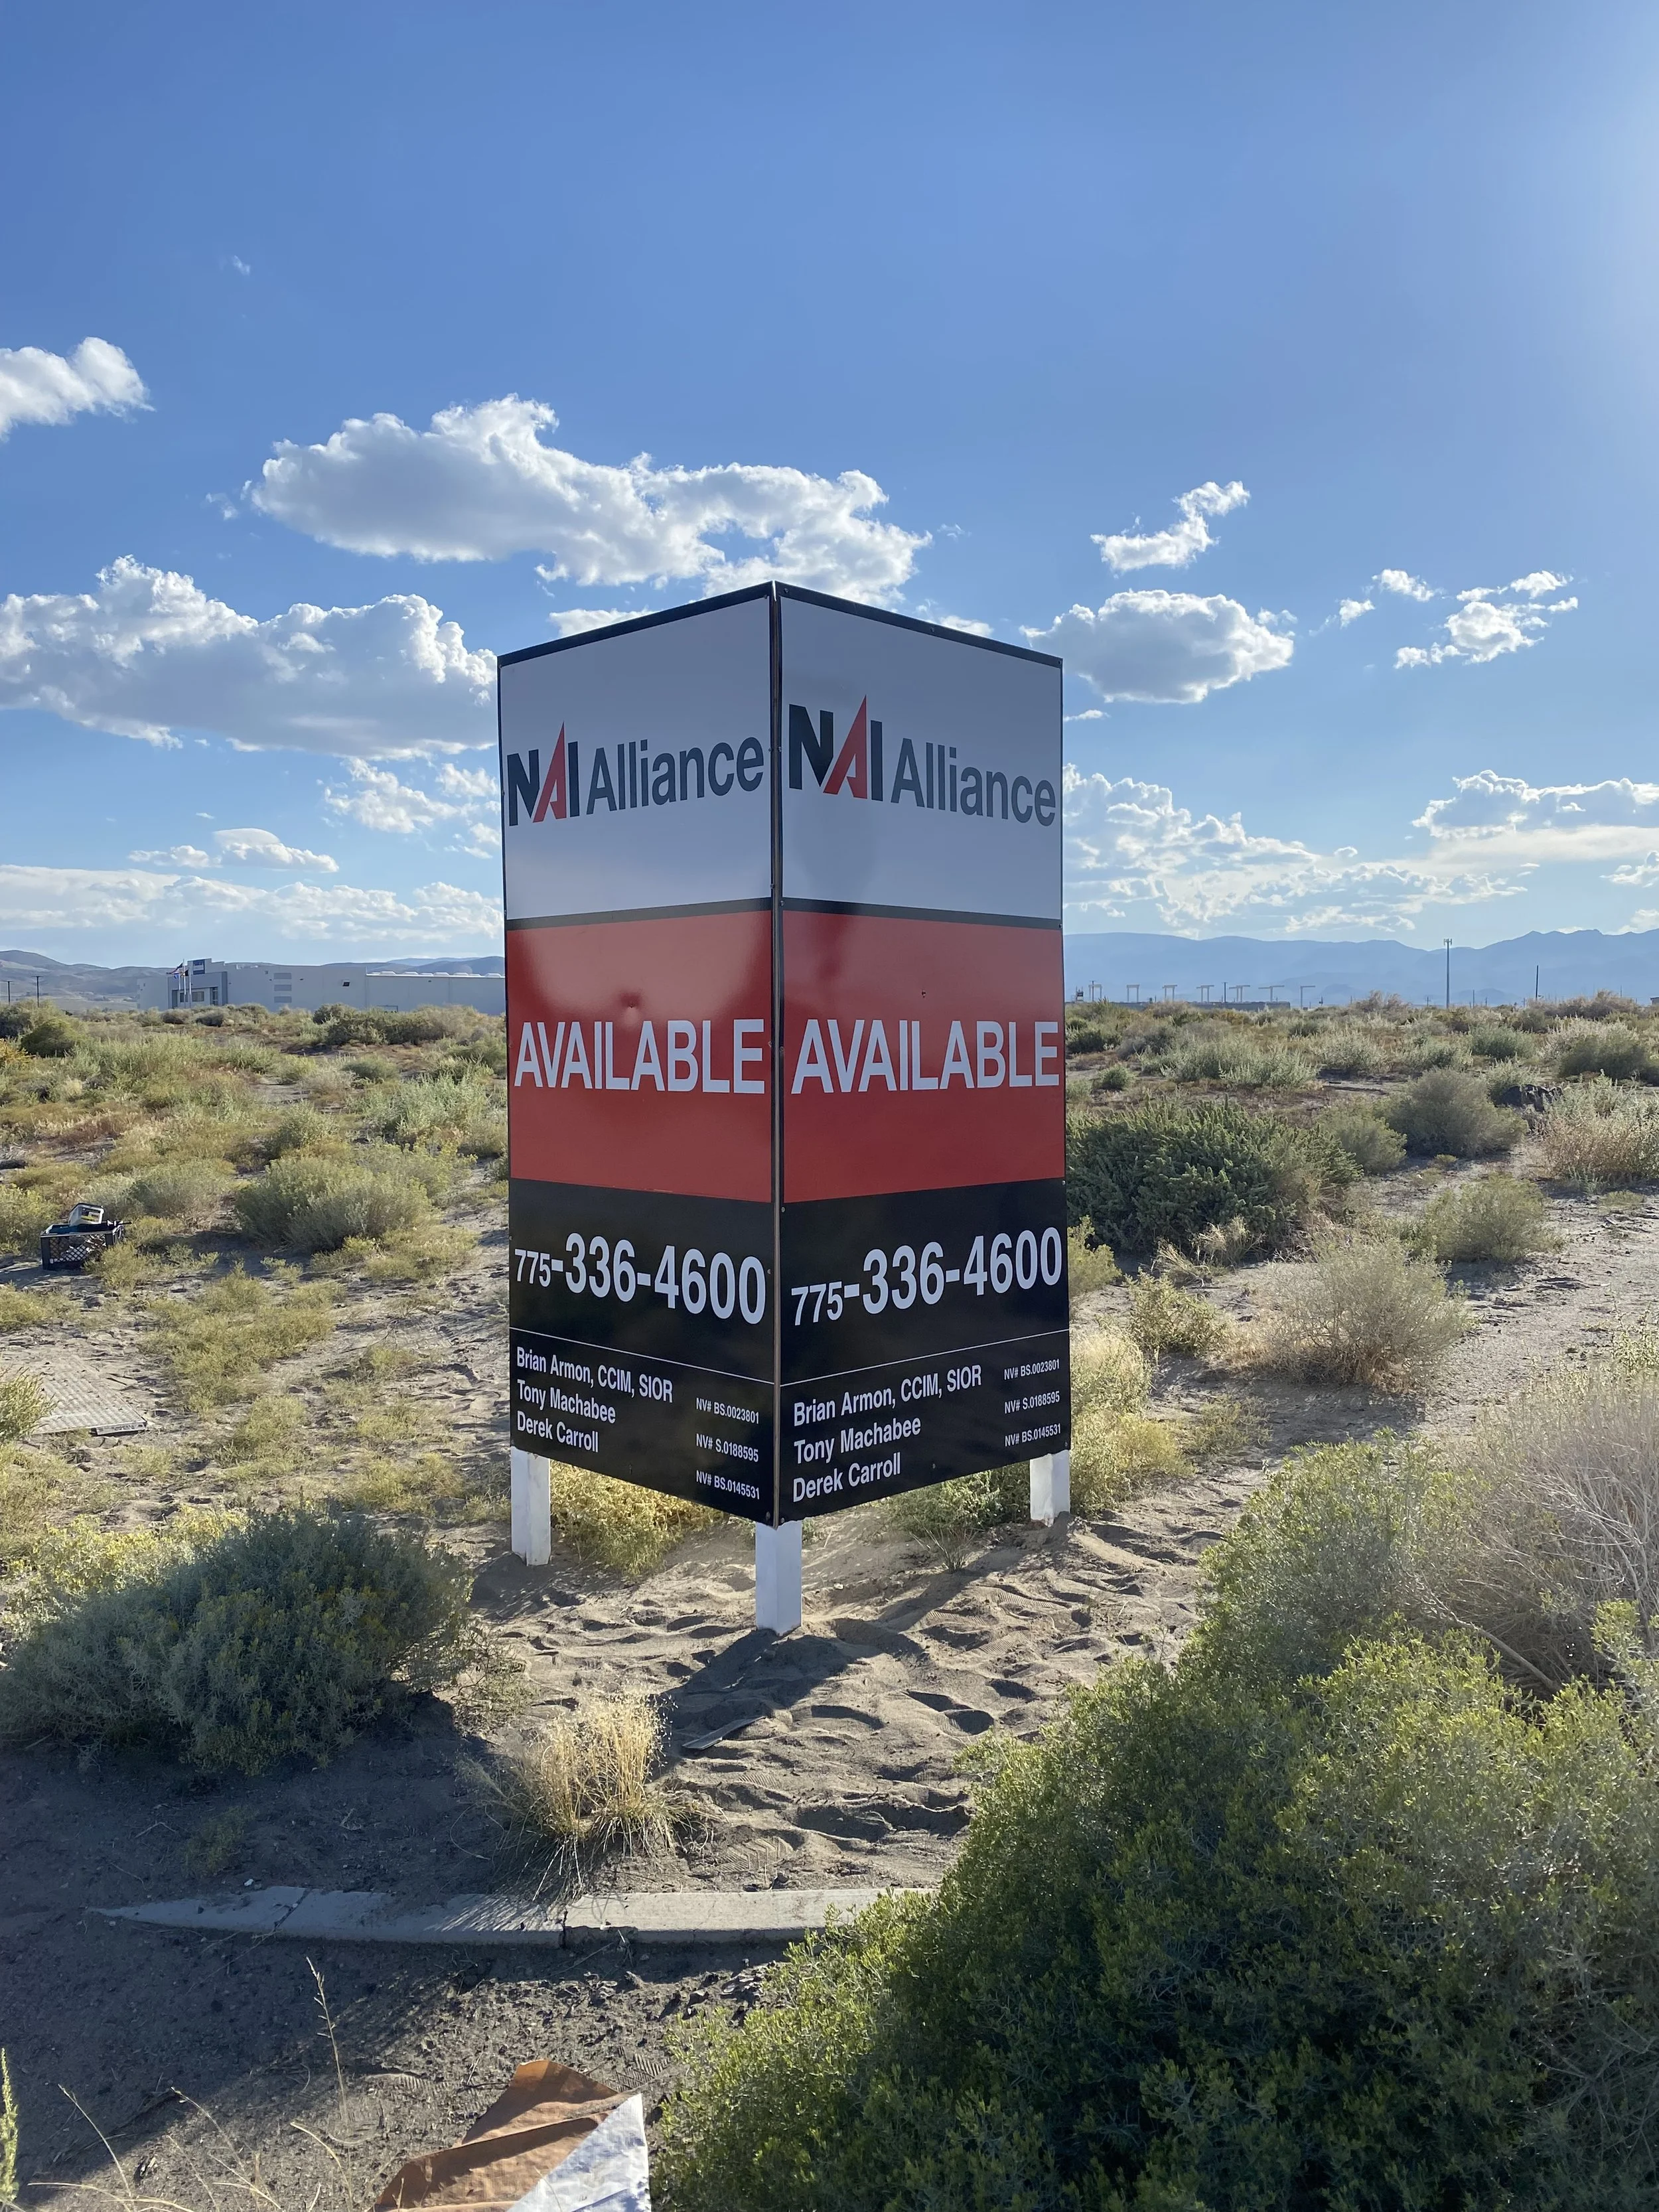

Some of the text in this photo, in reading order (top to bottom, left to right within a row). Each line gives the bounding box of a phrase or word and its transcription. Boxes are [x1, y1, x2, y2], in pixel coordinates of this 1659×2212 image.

[507, 721, 764, 826] NAI Alliance
[788, 694, 1056, 827] NAI Alliance
[514, 1019, 765, 1094] AVAILABLE
[791, 1019, 1060, 1095] AVAILABLE
[514, 1232, 766, 1325] 775-336-4600
[791, 1226, 1062, 1326] 775-336-4600
[516, 1346, 674, 1403] Brian Armon, CCIM, SIOR
[1004, 1358, 1060, 1380] NV# BS.0023801
[517, 1379, 616, 1424] Tony Machabee
[696, 1397, 759, 1424] NV# BS.0023801
[794, 1364, 982, 1427] Brian Armon, CCIM, SIOR
[1004, 1390, 1060, 1414] NV# S.0188595
[517, 1410, 599, 1453] Derek Carroll
[696, 1433, 758, 1463] NV# S.0188595
[794, 1417, 922, 1464] Tony Machabee
[1005, 1423, 1061, 1447] NV# BS.0145531
[696, 1469, 760, 1500] NV# BS.0145531
[793, 1451, 901, 1503] Derek Carroll
